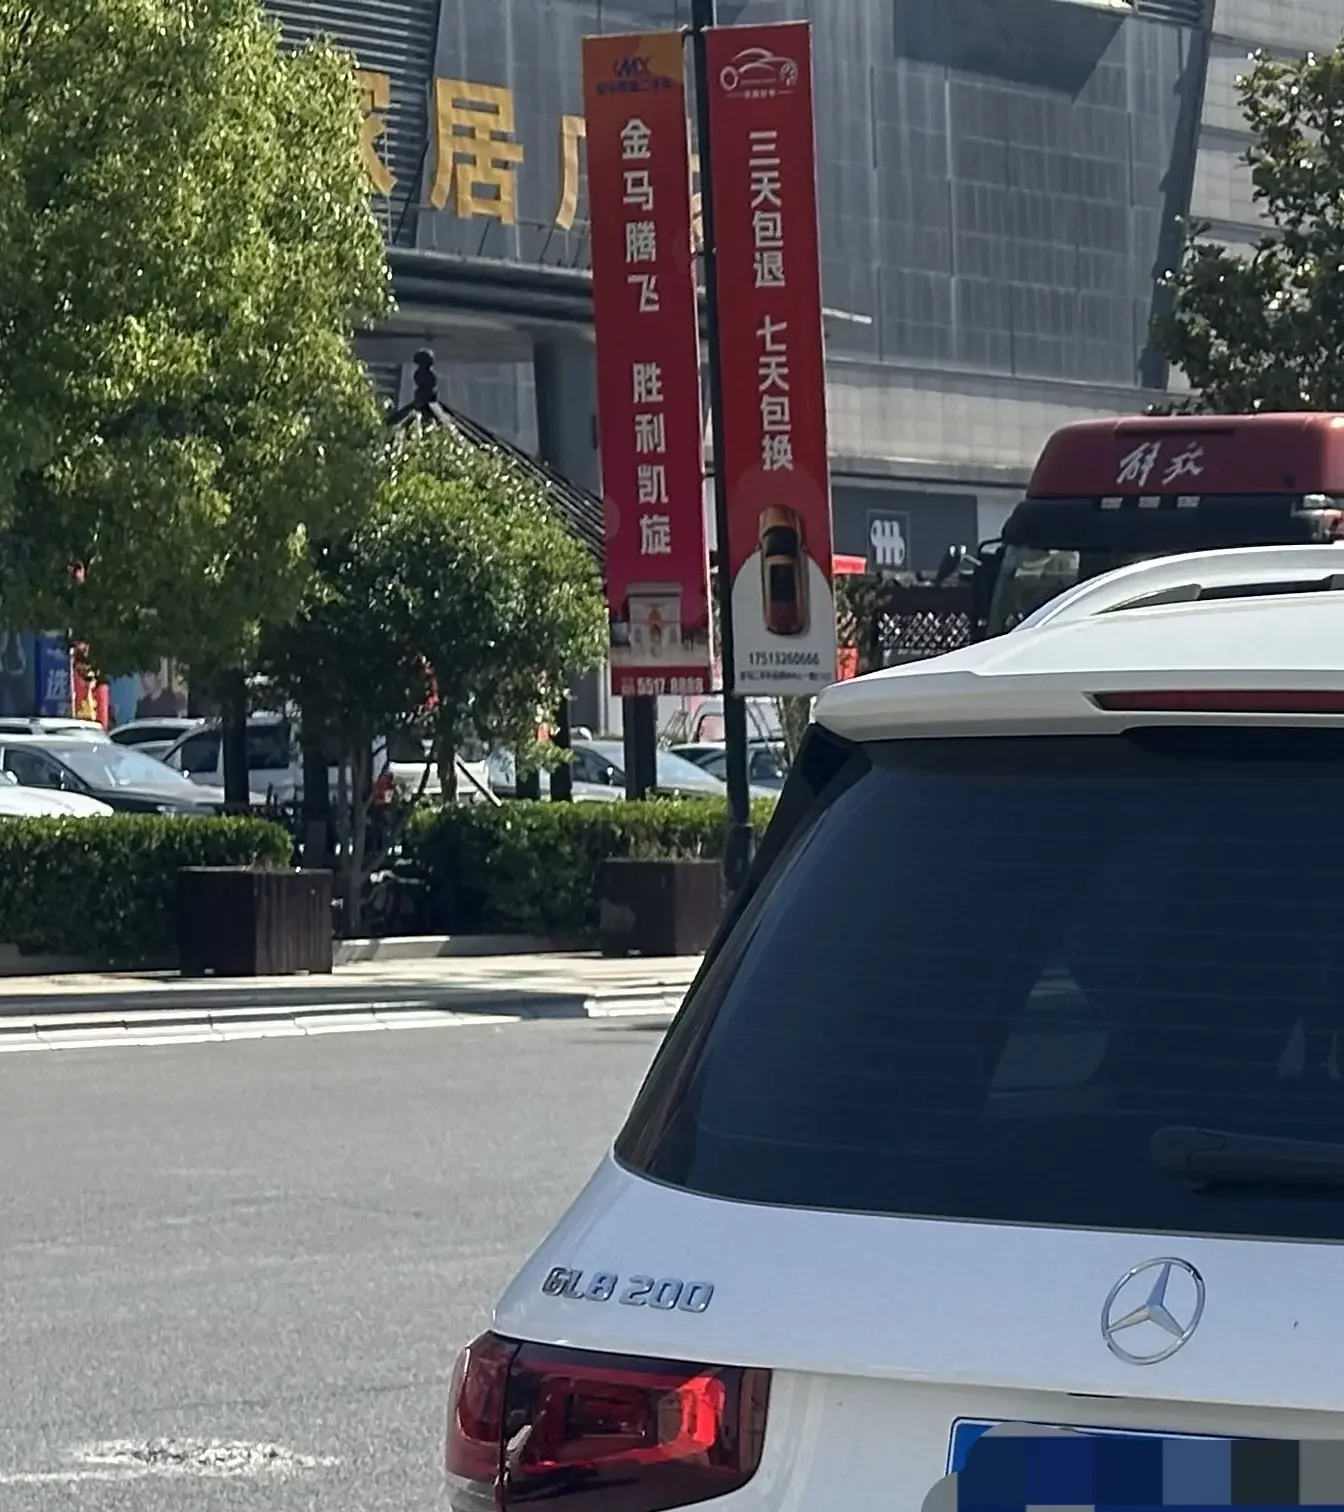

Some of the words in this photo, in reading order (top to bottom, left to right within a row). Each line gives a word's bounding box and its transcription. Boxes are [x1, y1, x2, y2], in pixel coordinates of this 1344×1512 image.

[620, 118, 660, 312] 金马腾飞
[749, 130, 786, 289] 三天包退
[632, 362, 671, 555] 胜利凯旋
[756, 314, 793, 471] 七天包换
[542, 1266, 618, 1301] GLB
[618, 1274, 715, 1313] 200
